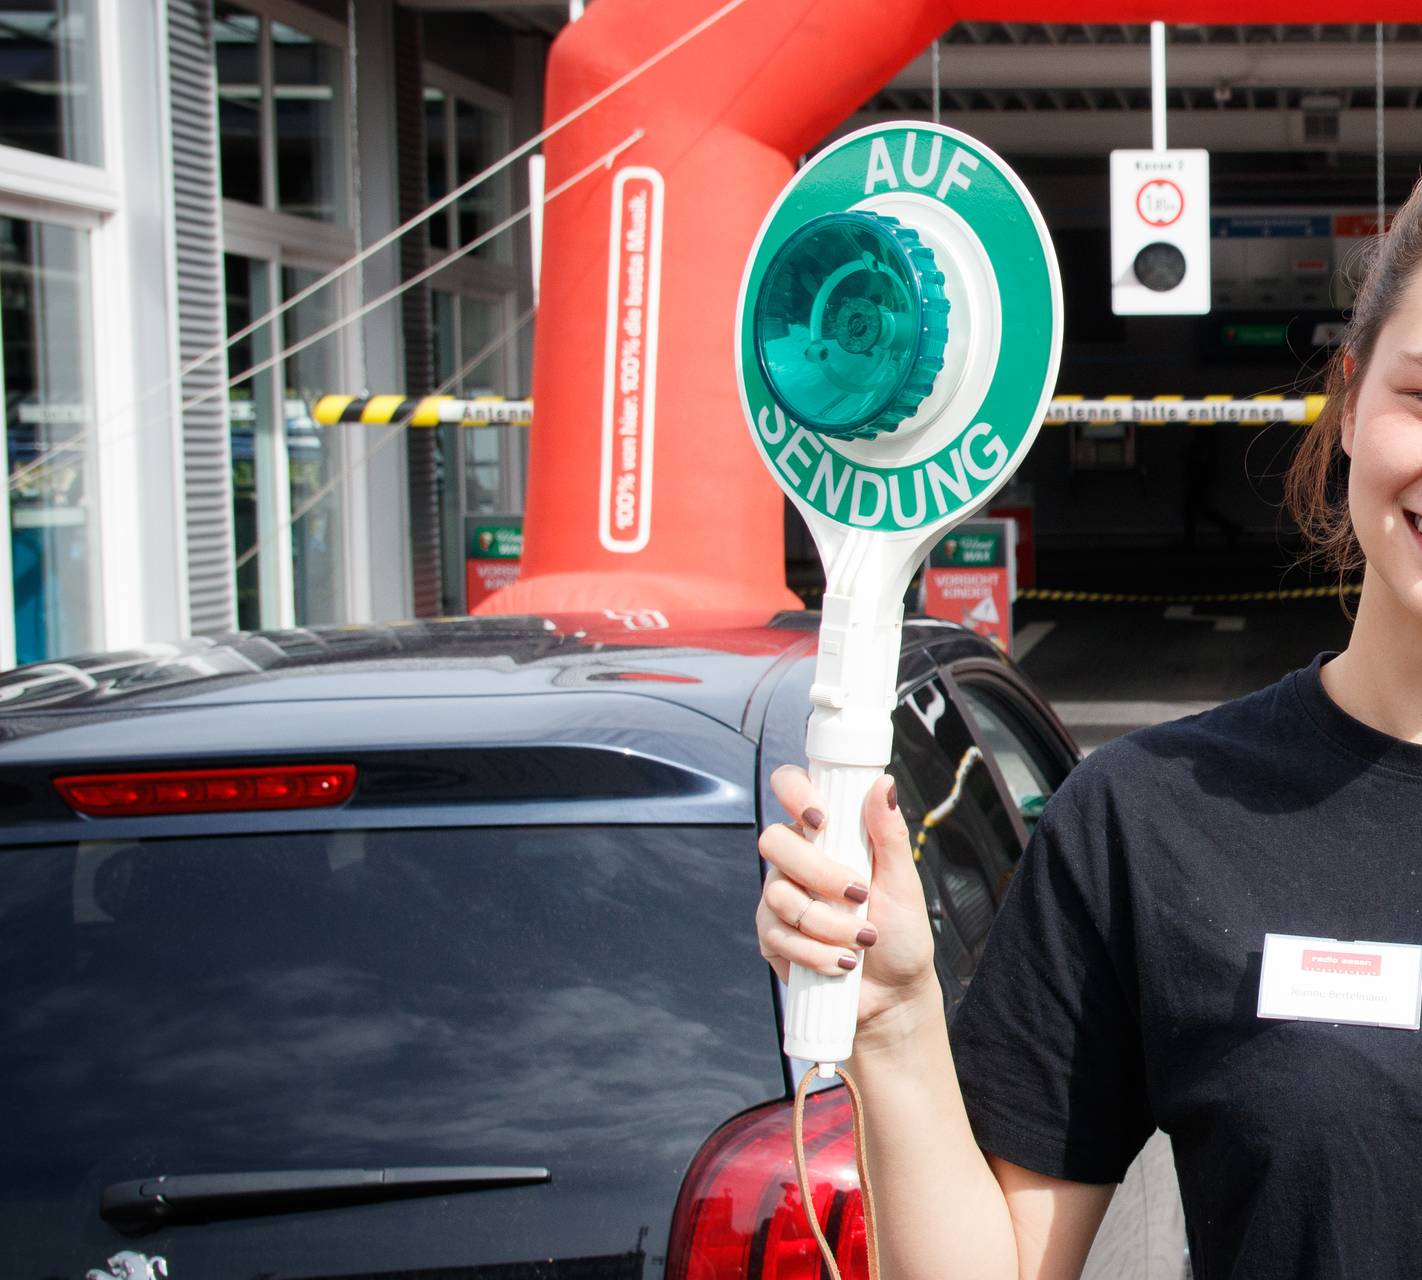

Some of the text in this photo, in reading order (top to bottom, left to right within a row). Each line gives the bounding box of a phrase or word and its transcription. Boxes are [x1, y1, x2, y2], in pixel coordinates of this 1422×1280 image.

[864, 131, 981, 200] AUF
[623, 309, 642, 337] die
[620, 338, 641, 394] 100%
[463, 406, 531, 420] Antenn
[757, 404, 1009, 528] SENDUNG
[616, 473, 636, 530] 100%
